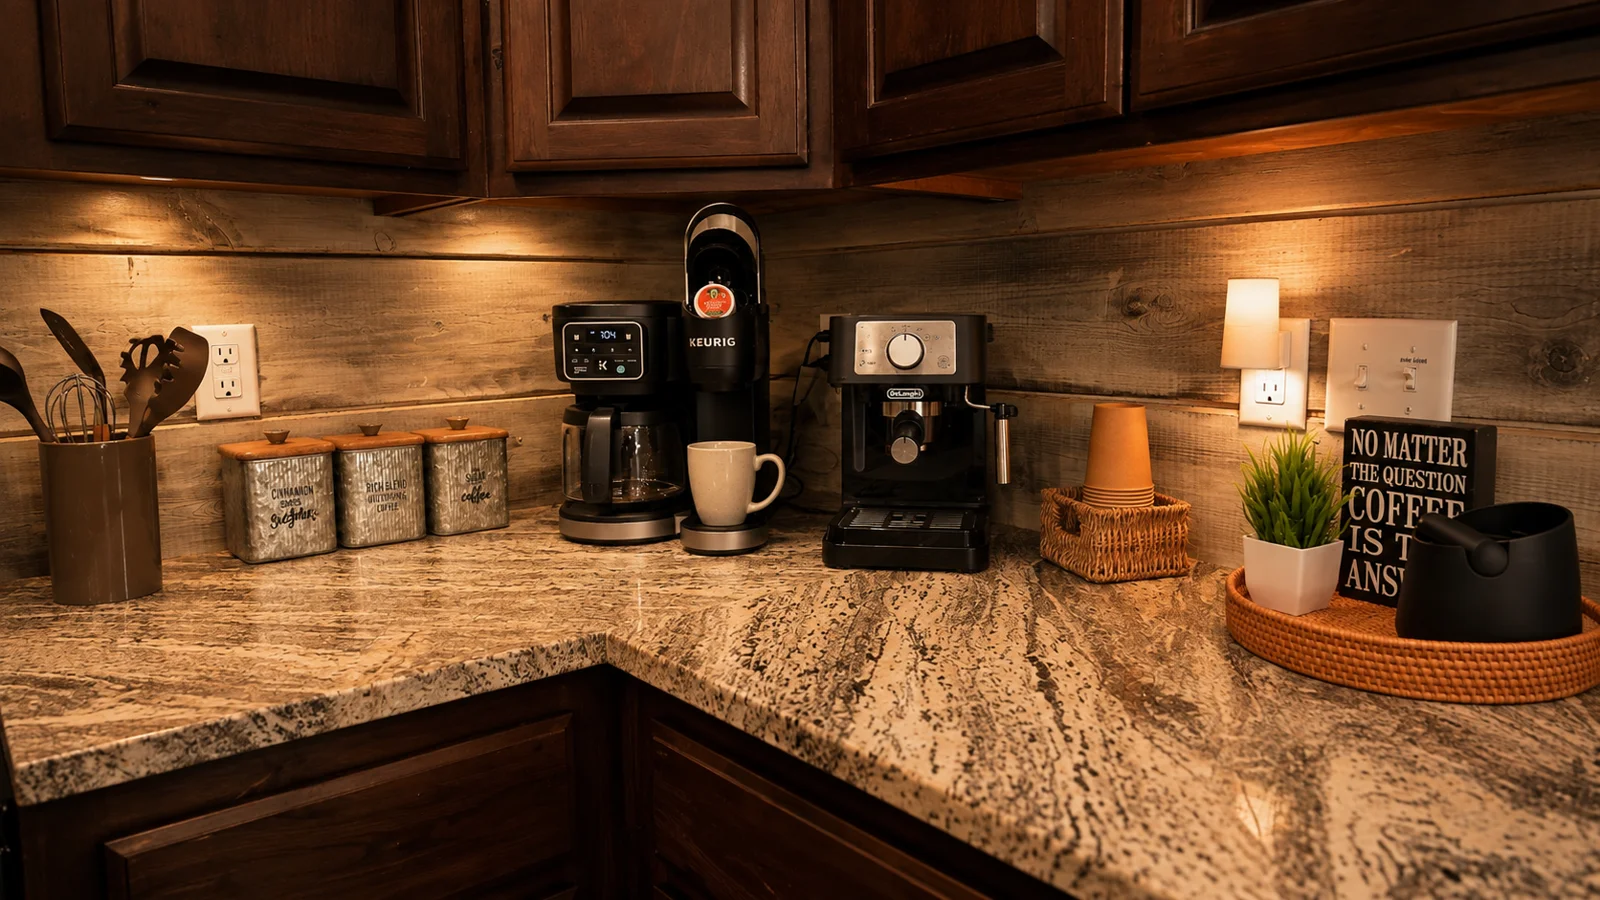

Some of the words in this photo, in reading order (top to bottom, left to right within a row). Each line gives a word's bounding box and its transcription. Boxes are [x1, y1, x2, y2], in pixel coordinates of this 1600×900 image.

[689, 337, 736, 347] KEURIG
[1350, 428, 1379, 457] NO
[1383, 430, 1468, 468] MATTER
[1349, 461, 1380, 483] THE
[1382, 465, 1467, 495] QUESTION
[1348, 524, 1383, 556] IS
[1344, 558, 1406, 598] ANS
